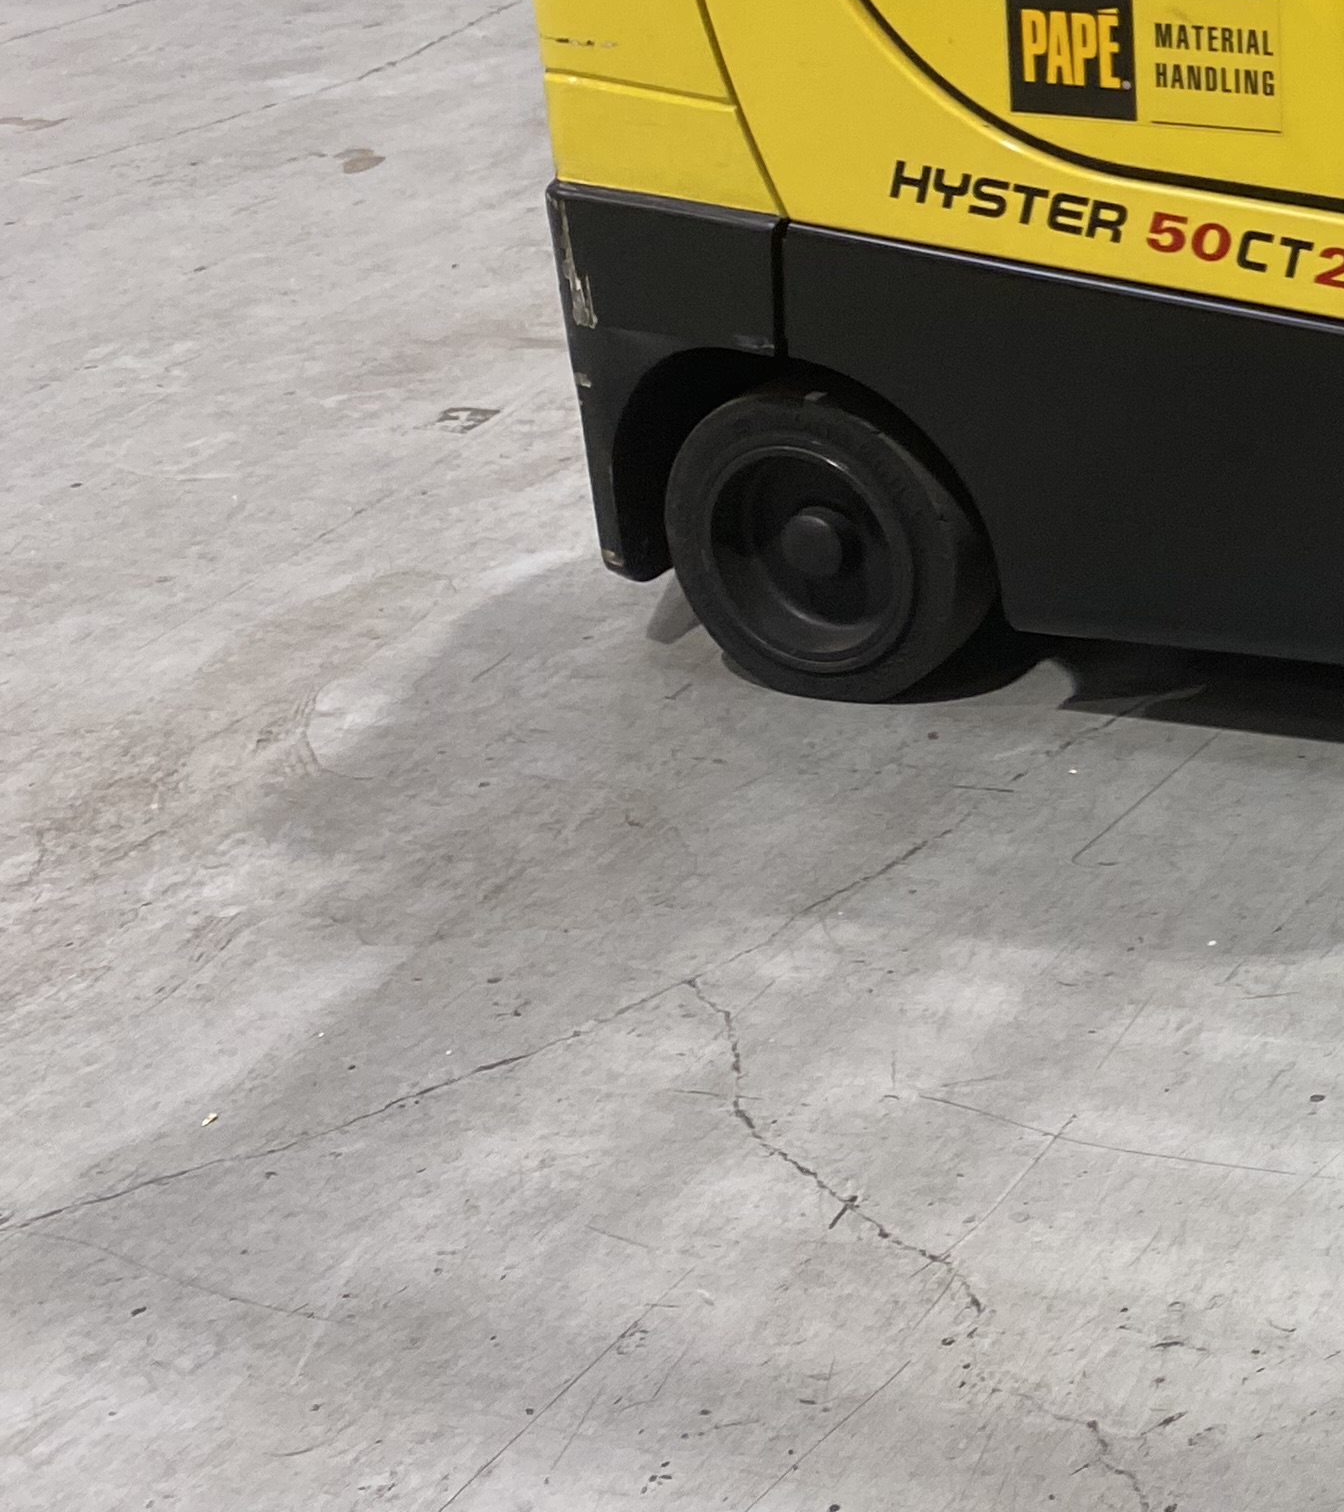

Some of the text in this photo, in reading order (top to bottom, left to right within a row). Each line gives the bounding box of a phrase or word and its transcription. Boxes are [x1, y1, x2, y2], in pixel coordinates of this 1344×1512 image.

[1154, 22, 1275, 56] MATERIAL
[1154, 62, 1275, 97] HANDLING
[889, 160, 1129, 244] HYSTER
